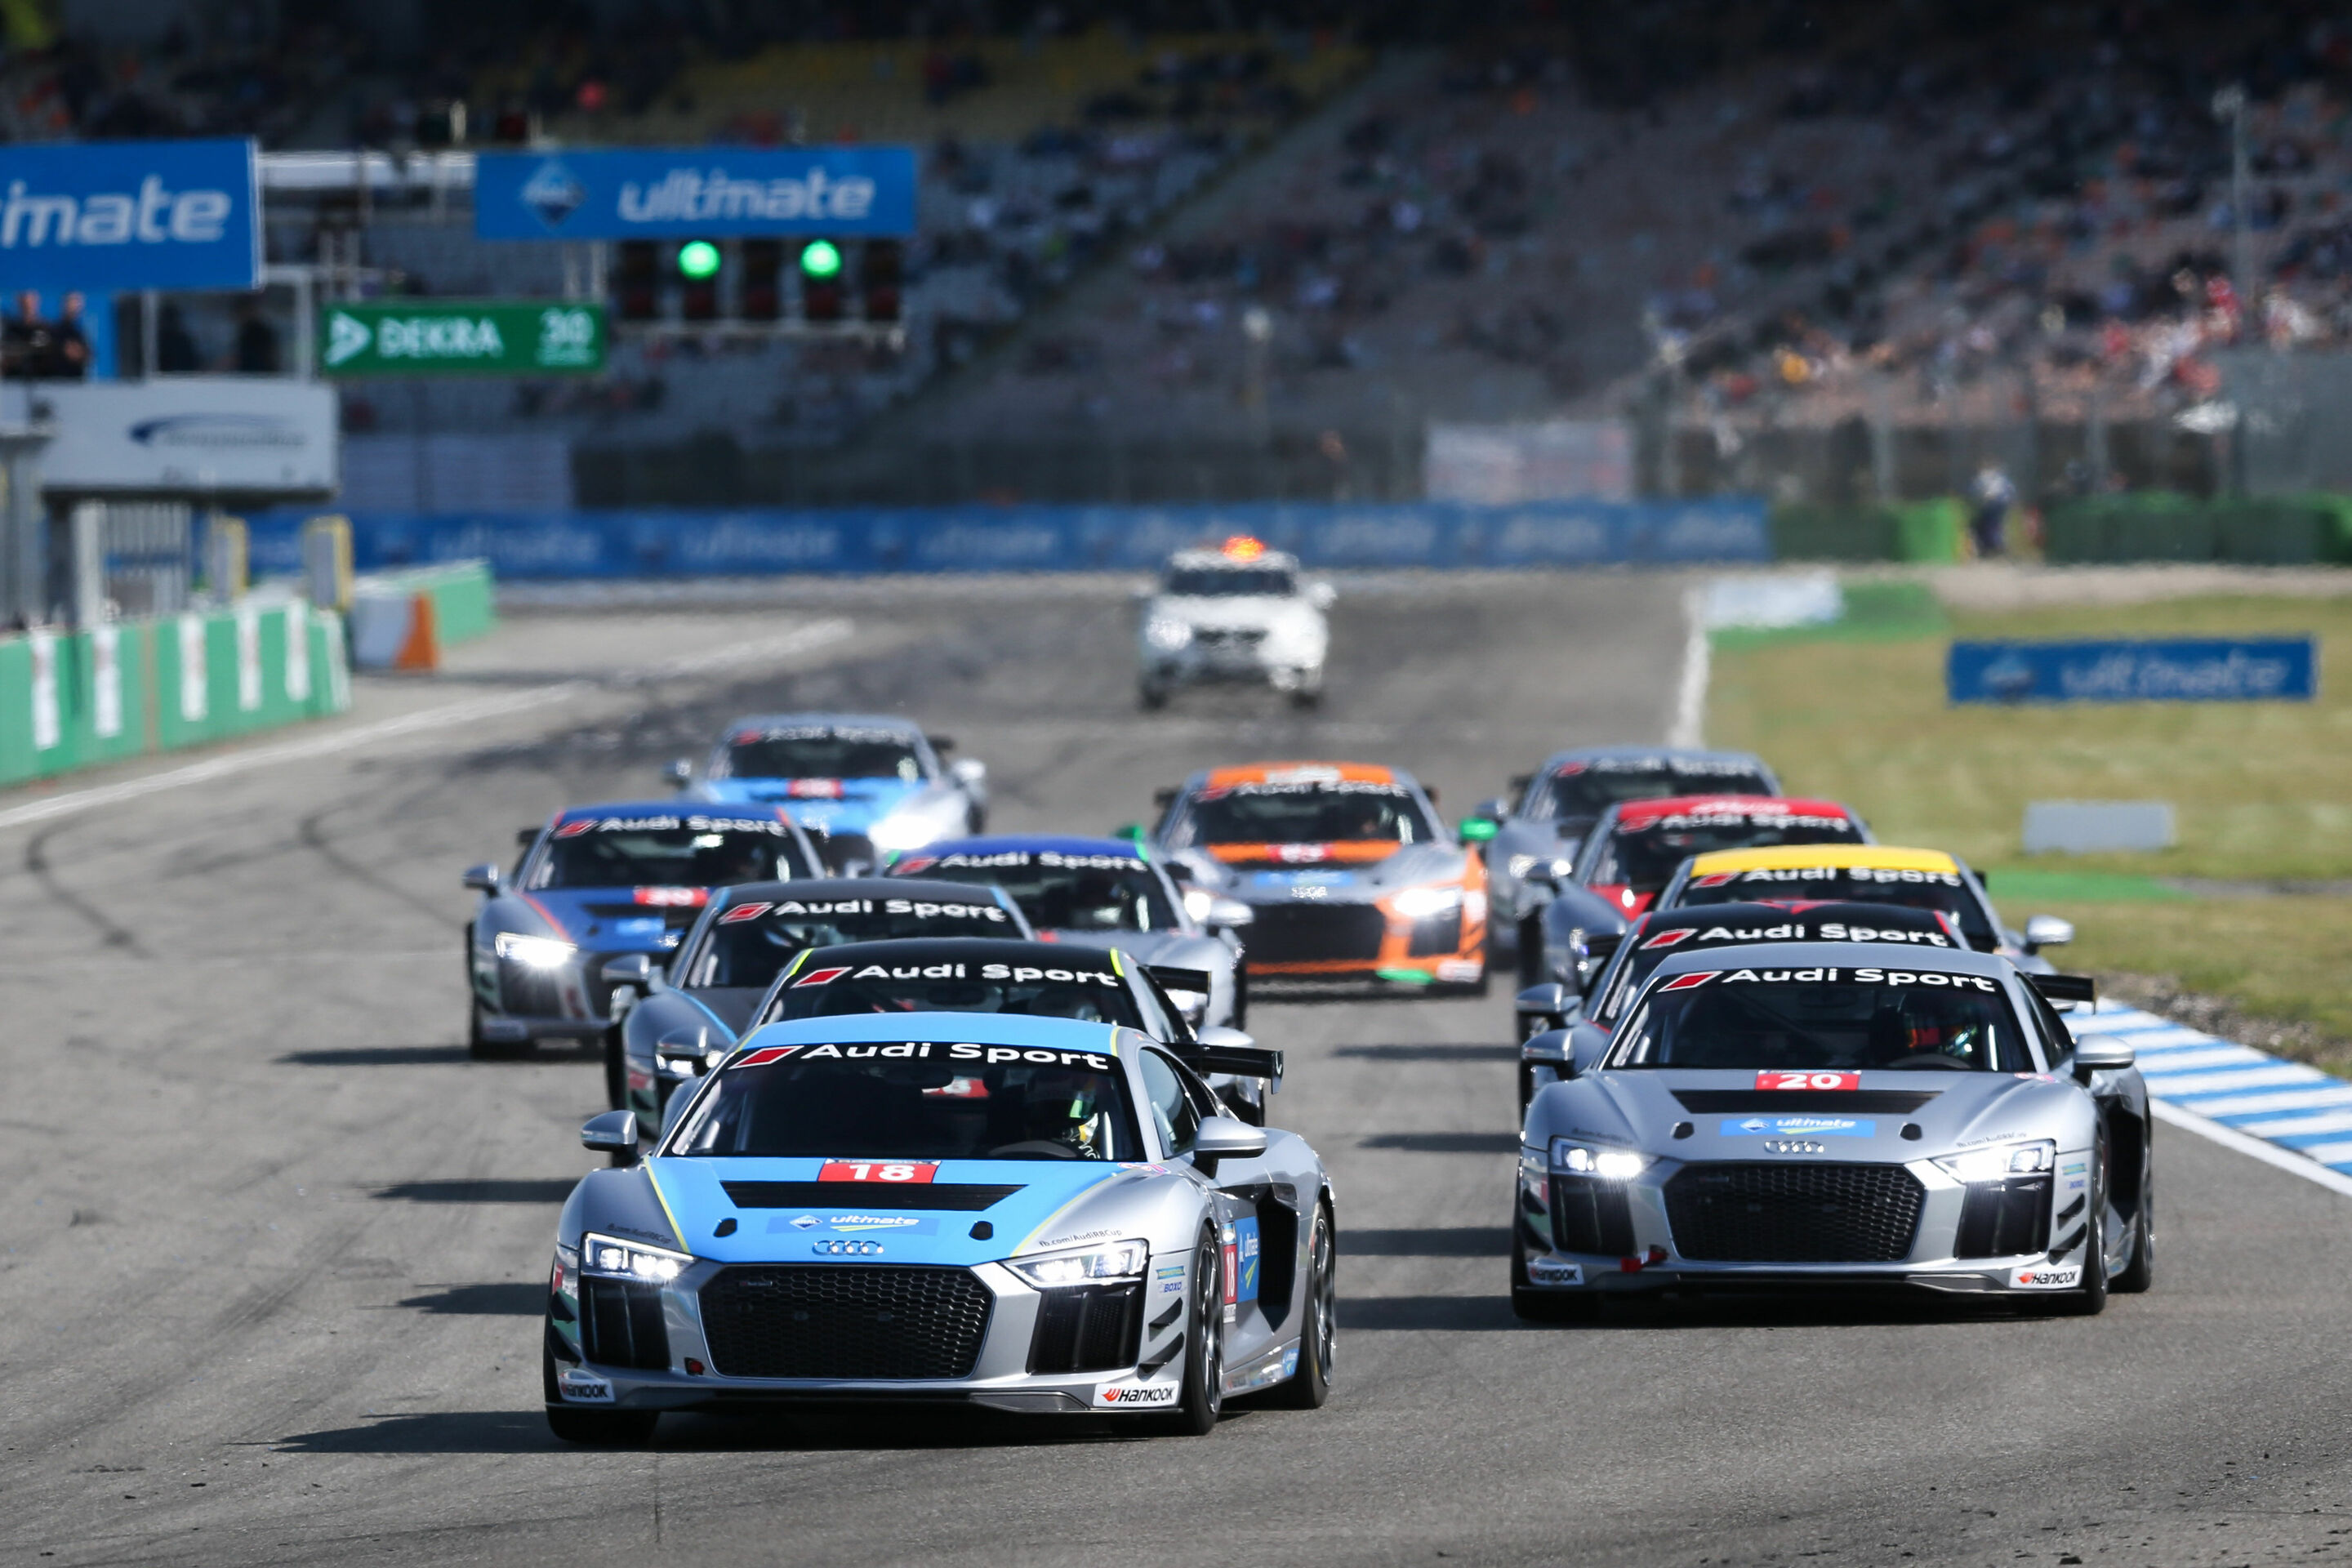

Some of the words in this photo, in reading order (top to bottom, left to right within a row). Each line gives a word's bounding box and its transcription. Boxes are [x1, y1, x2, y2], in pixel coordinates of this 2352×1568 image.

[617, 165, 875, 222] ultimate
[378, 316, 505, 359] DEKRA
[2060, 648, 2287, 695] ultimate
[596, 815, 680, 832] Audi
[687, 815, 788, 837] Sport
[940, 851, 1030, 869] Audi
[1038, 851, 1148, 872] Sport
[1743, 866, 1837, 882] Audi
[1847, 866, 1962, 888] Sport
[774, 899, 872, 916] Audi
[884, 899, 1006, 923] Sport
[1699, 924, 1806, 941] Audi
[1819, 923, 1949, 947] Sport
[852, 964, 966, 979] Audi
[982, 964, 1119, 987] Sport
[1722, 968, 1838, 983] Audi
[1854, 968, 1997, 992] Sport
[800, 1042, 931, 1060] Audi
[949, 1043, 1109, 1071] Sport
[1775, 1073, 1842, 1090] 20
[1775, 1117, 1856, 1129] ultimate
[849, 1164, 915, 1182] 18
[830, 1214, 920, 1225] ultimate
[1038, 1229, 1123, 1248] fb.com/AudiR8Cup
